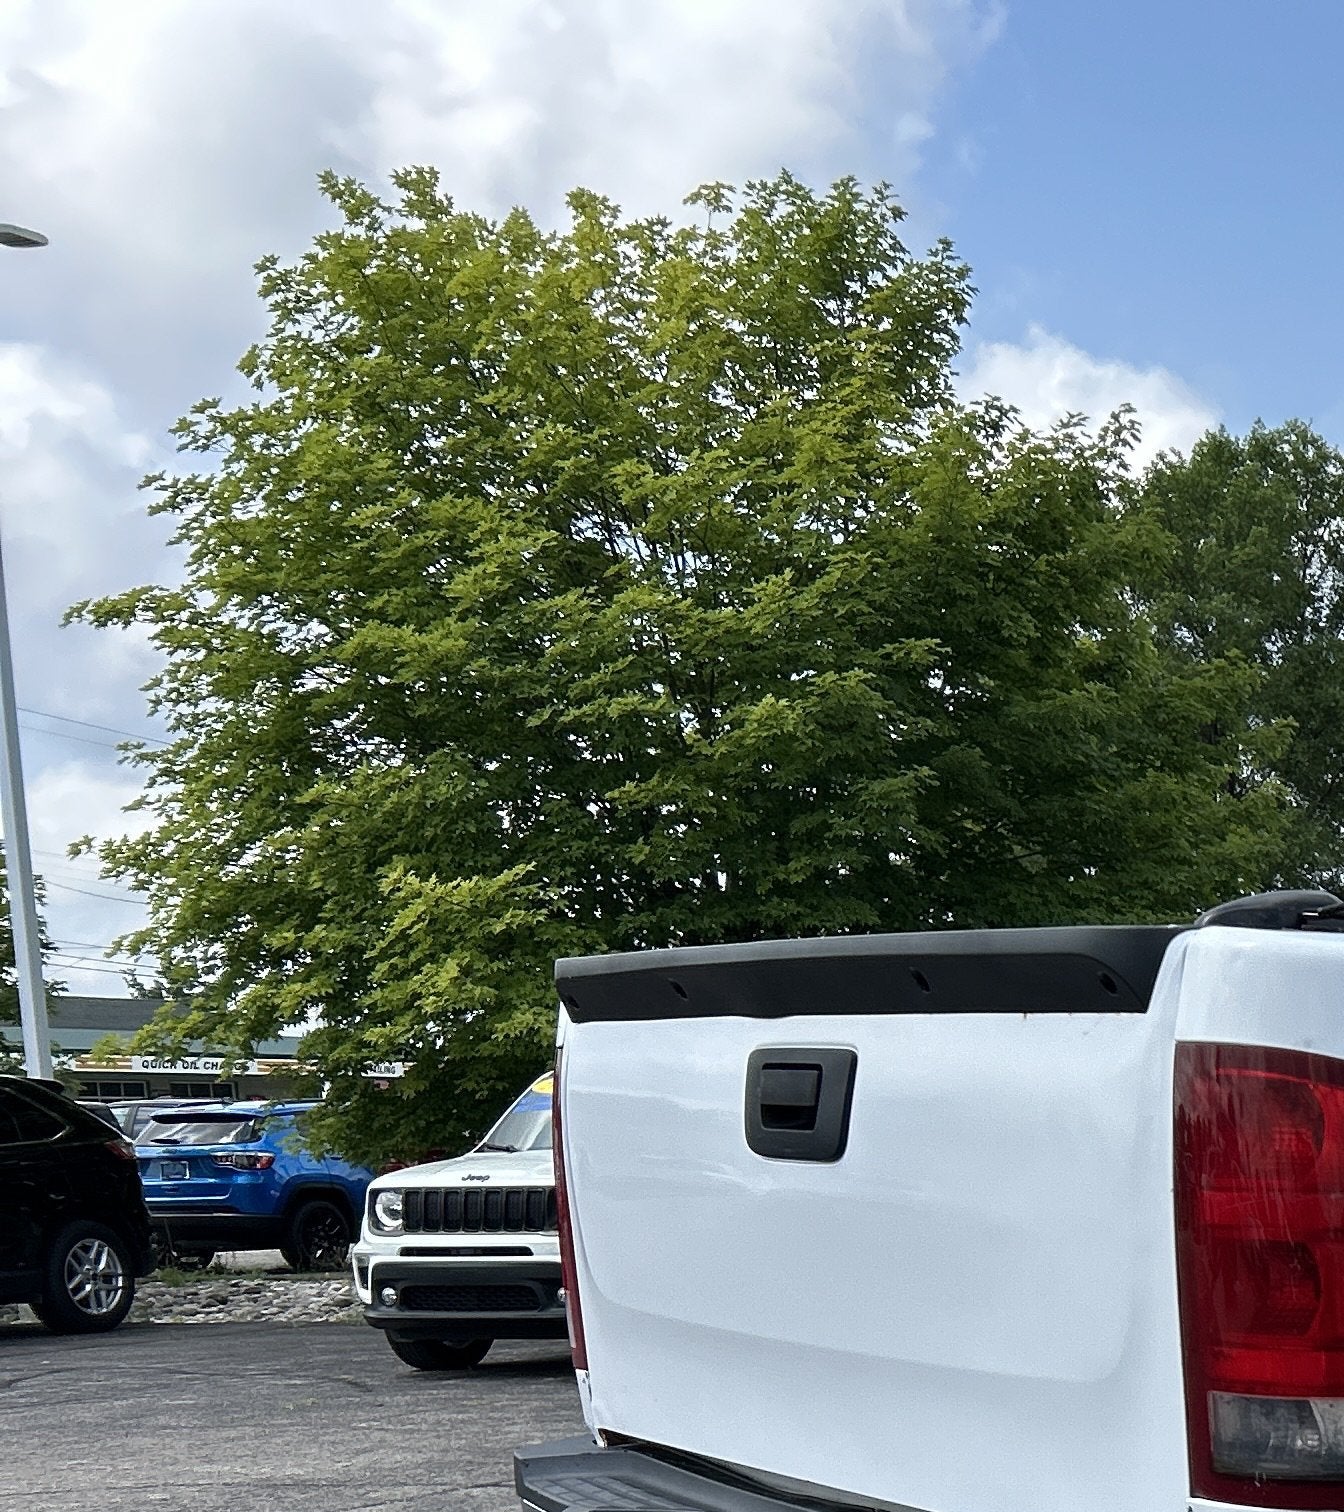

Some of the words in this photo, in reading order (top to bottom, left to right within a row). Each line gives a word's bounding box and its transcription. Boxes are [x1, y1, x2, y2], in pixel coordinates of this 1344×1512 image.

[142, 1060, 178, 1070] QUICK
[181, 1060, 200, 1070] OIL
[461, 1174, 491, 1182] Jeep
